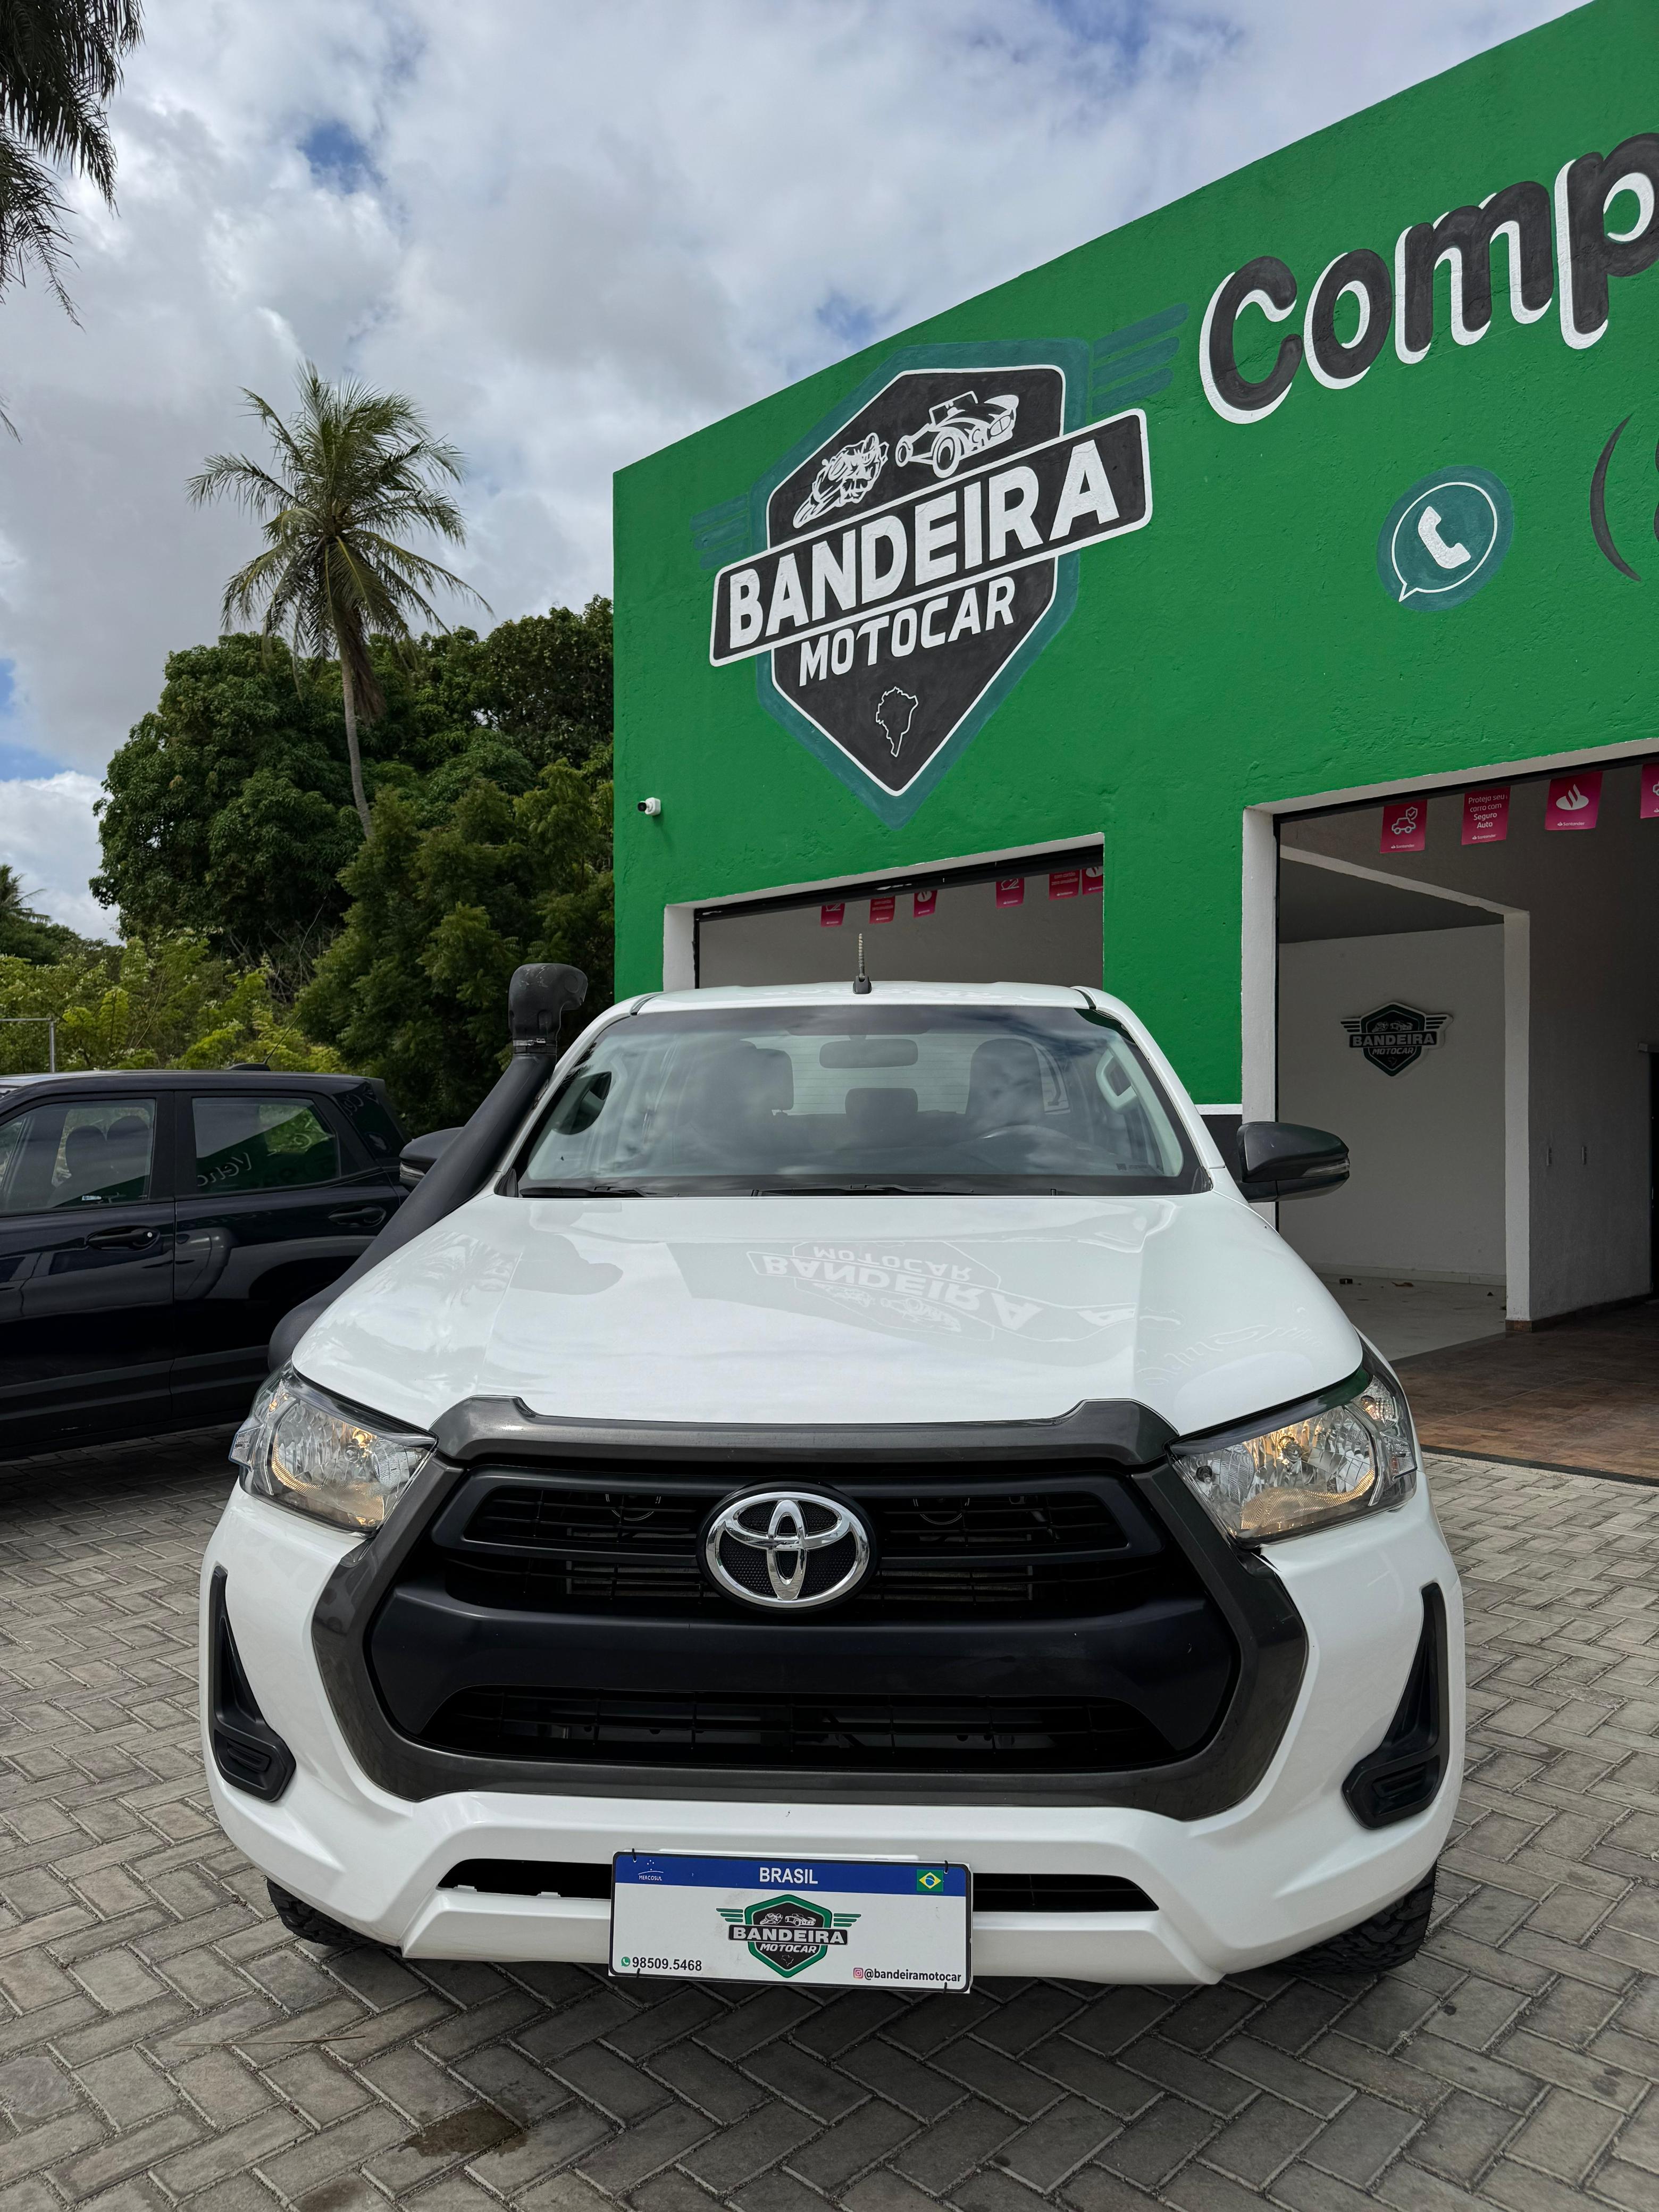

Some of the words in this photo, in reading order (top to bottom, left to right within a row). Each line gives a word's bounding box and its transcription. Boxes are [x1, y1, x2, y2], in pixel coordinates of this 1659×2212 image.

[729, 439, 1120, 649] BANDEIRA
[799, 576, 1016, 686] MOTOCAR
[1473, 812, 1497, 821] Seguro
[1352, 1033, 1435, 1046] BANDEIRA
[759, 1867, 818, 1884] BRASIL
[733, 1926, 844, 1944] BANDEIRA
[759, 1943, 817, 1953] MOTOCAR
[632, 1957, 702, 1971] 98509.5468
[864, 1968, 961, 1982] @bandeiramotocar
